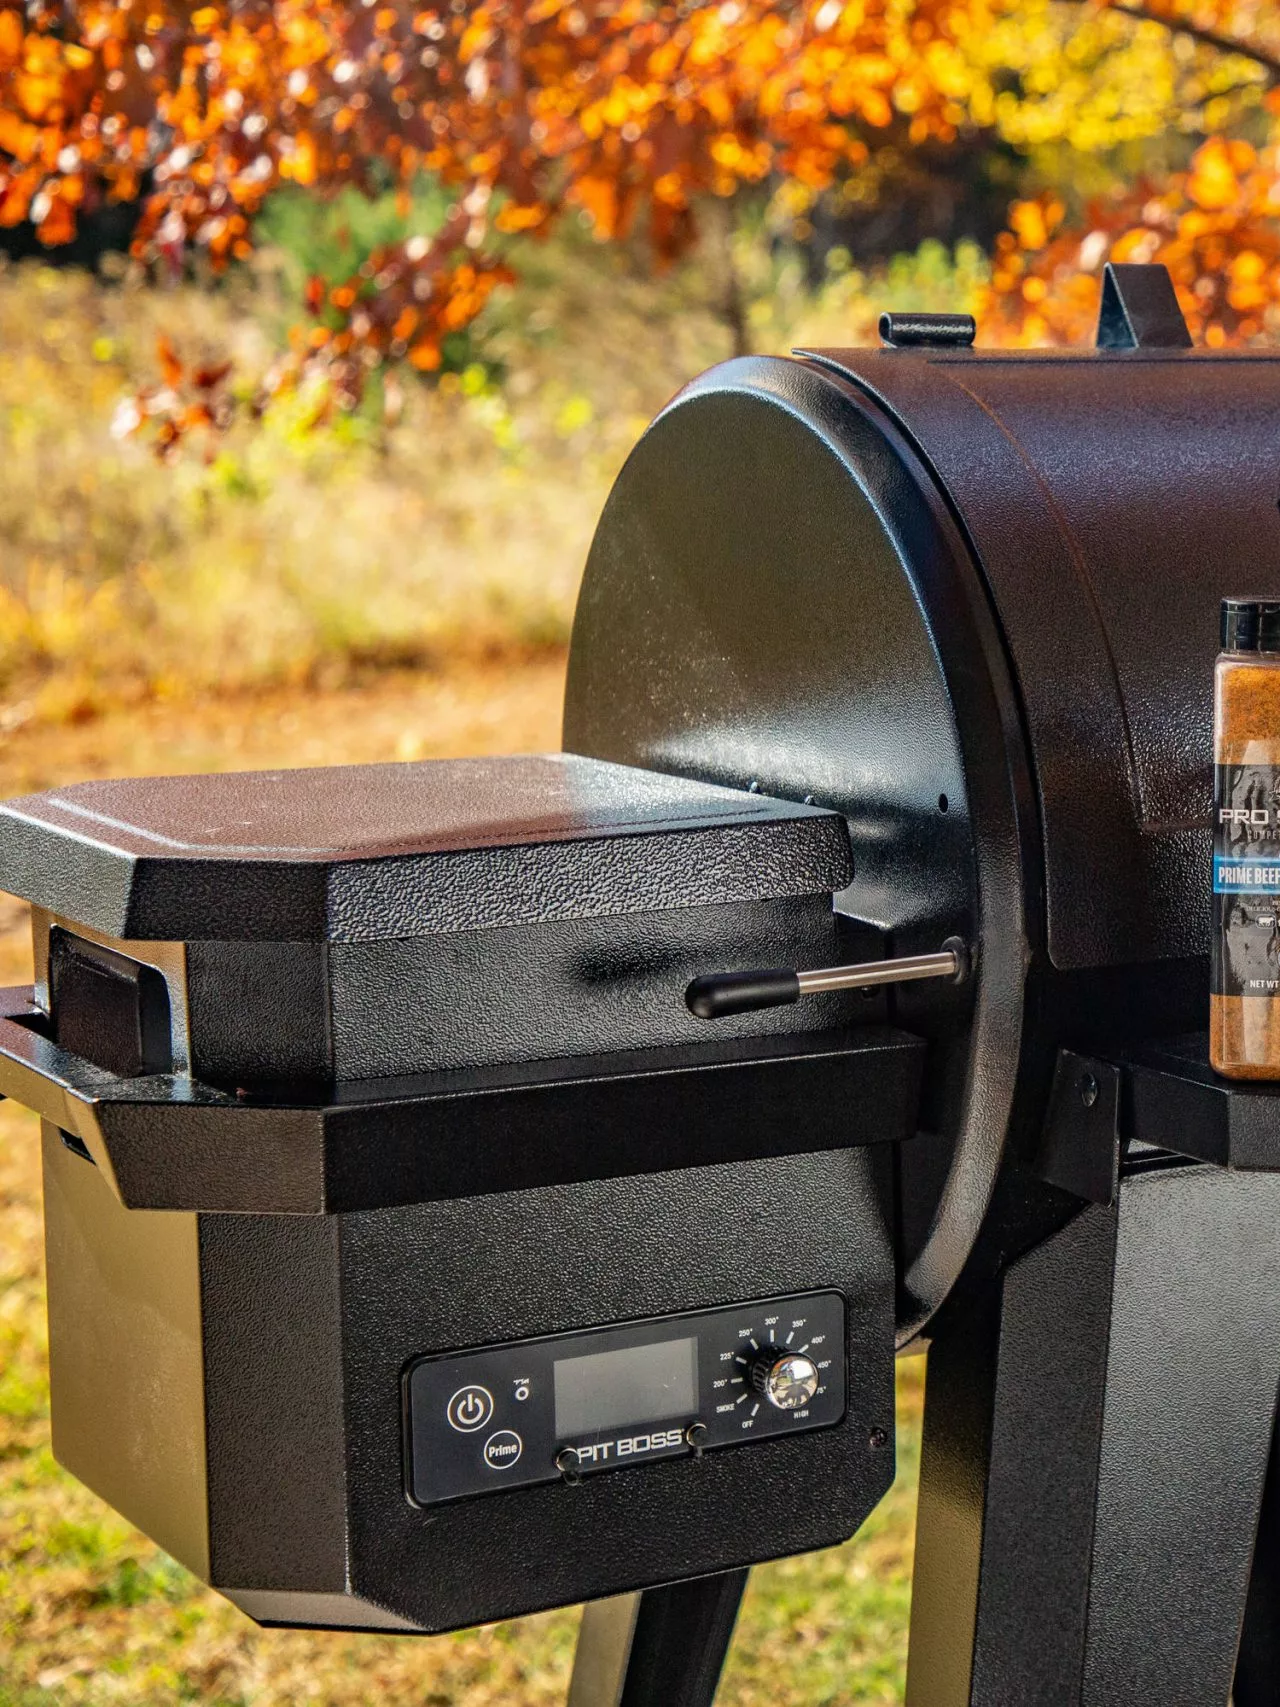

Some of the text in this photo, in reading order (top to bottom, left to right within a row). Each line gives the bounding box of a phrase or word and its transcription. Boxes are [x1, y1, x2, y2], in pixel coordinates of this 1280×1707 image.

[1219, 809, 1269, 825] PRO
[1218, 866, 1252, 884] PRIME
[1254, 867, 1280, 884] BEEF
[1250, 980, 1265, 989] NET
[1265, 980, 1279, 989] WT
[716, 1403, 735, 1413] SMOKE
[793, 1409, 809, 1419] HIGH
[742, 1420, 754, 1429] OFF
[488, 1444, 518, 1458] Prime
[577, 1429, 683, 1464] PIT BOSS
